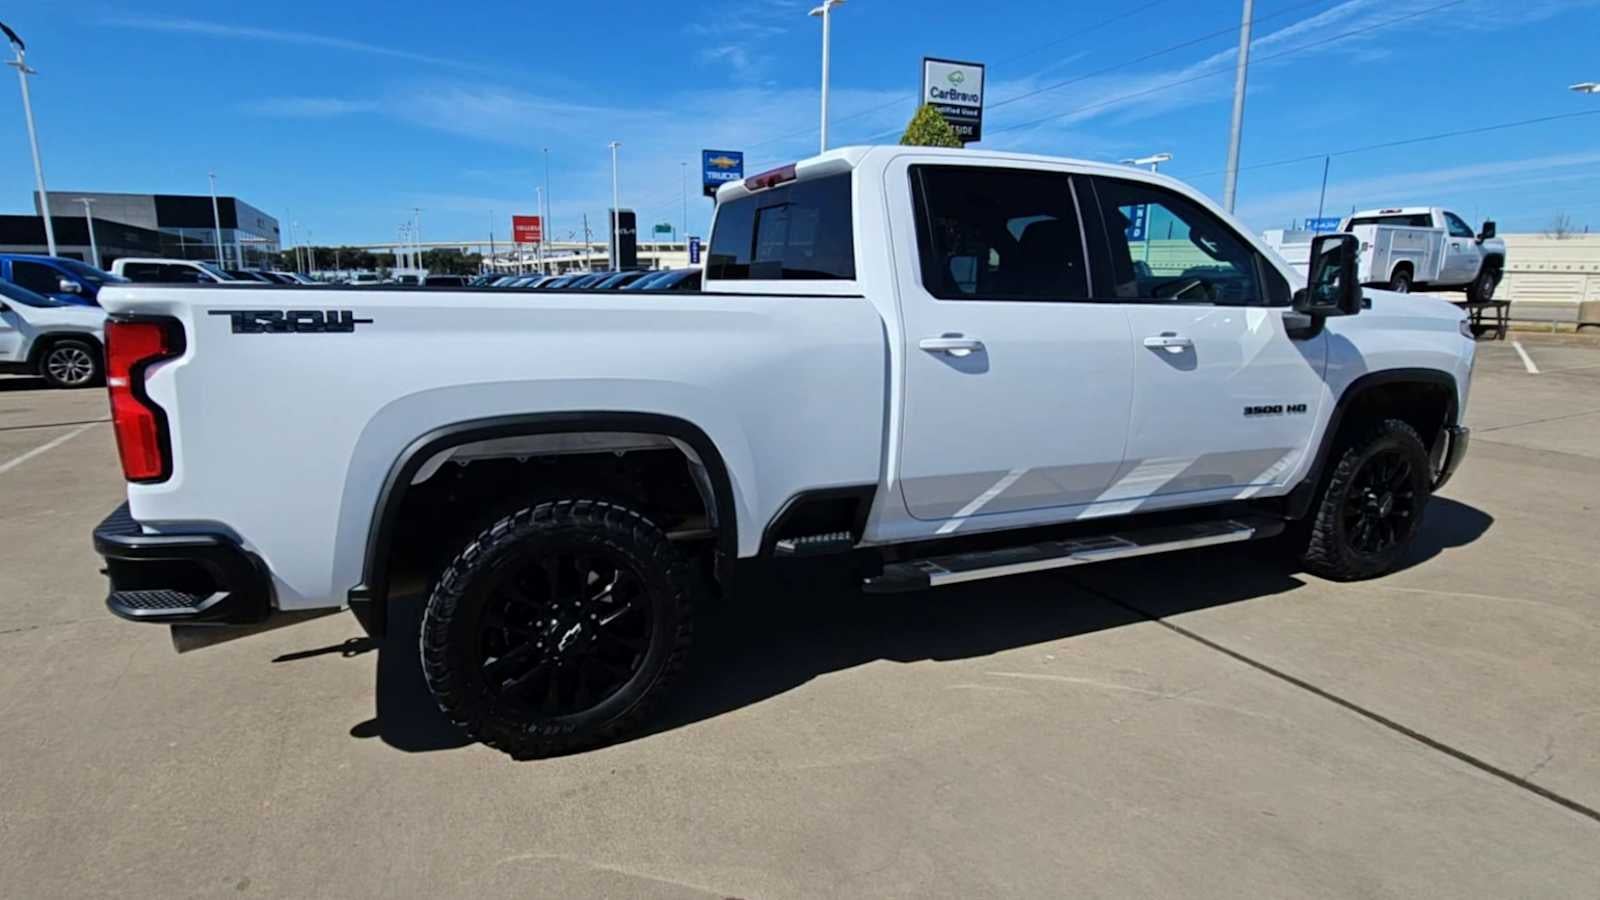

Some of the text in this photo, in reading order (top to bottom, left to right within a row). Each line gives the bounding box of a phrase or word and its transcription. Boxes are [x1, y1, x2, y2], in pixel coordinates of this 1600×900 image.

[930, 86, 979, 103] CarBravo
[1243, 403, 1308, 416] 3500 HD
